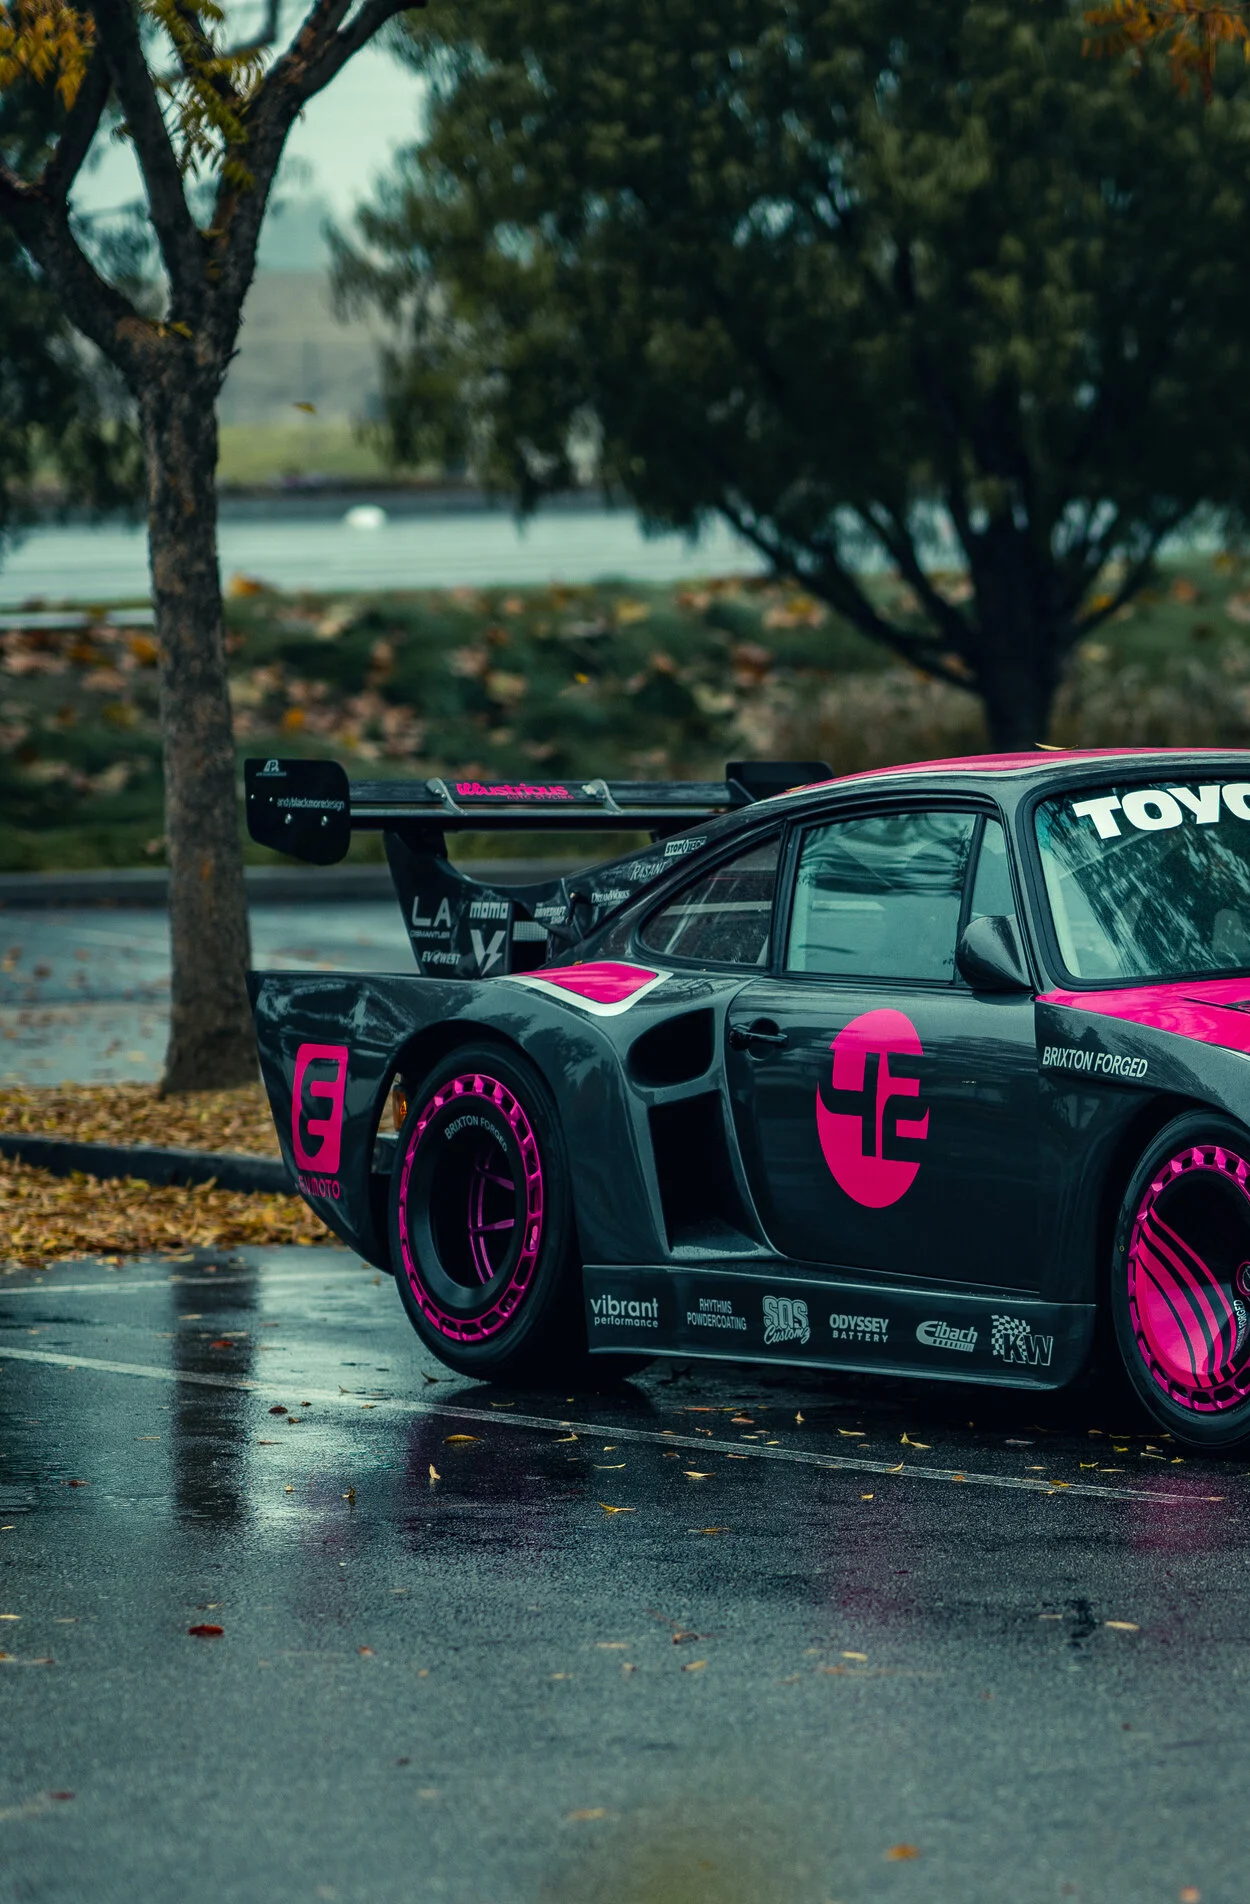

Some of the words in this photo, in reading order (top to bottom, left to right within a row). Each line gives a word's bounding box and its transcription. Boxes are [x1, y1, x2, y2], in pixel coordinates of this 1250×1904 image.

[411, 896, 452, 928] LA
[1042, 1046, 1094, 1070] BRIXTON
[1094, 1053, 1148, 1078] FORGED
[444, 1115, 478, 1139] BRIXTON
[590, 1294, 659, 1318] vibrant
[699, 1298, 732, 1314] RHYTHMS
[594, 1315, 659, 1327] performance
[687, 1312, 747, 1330] POWDERCOATING
[829, 1313, 889, 1333] ODYSSEY
[916, 1320, 978, 1346] Eibach
[832, 1331, 889, 1343] BATTERY
[1002, 1332, 1054, 1366] KW
